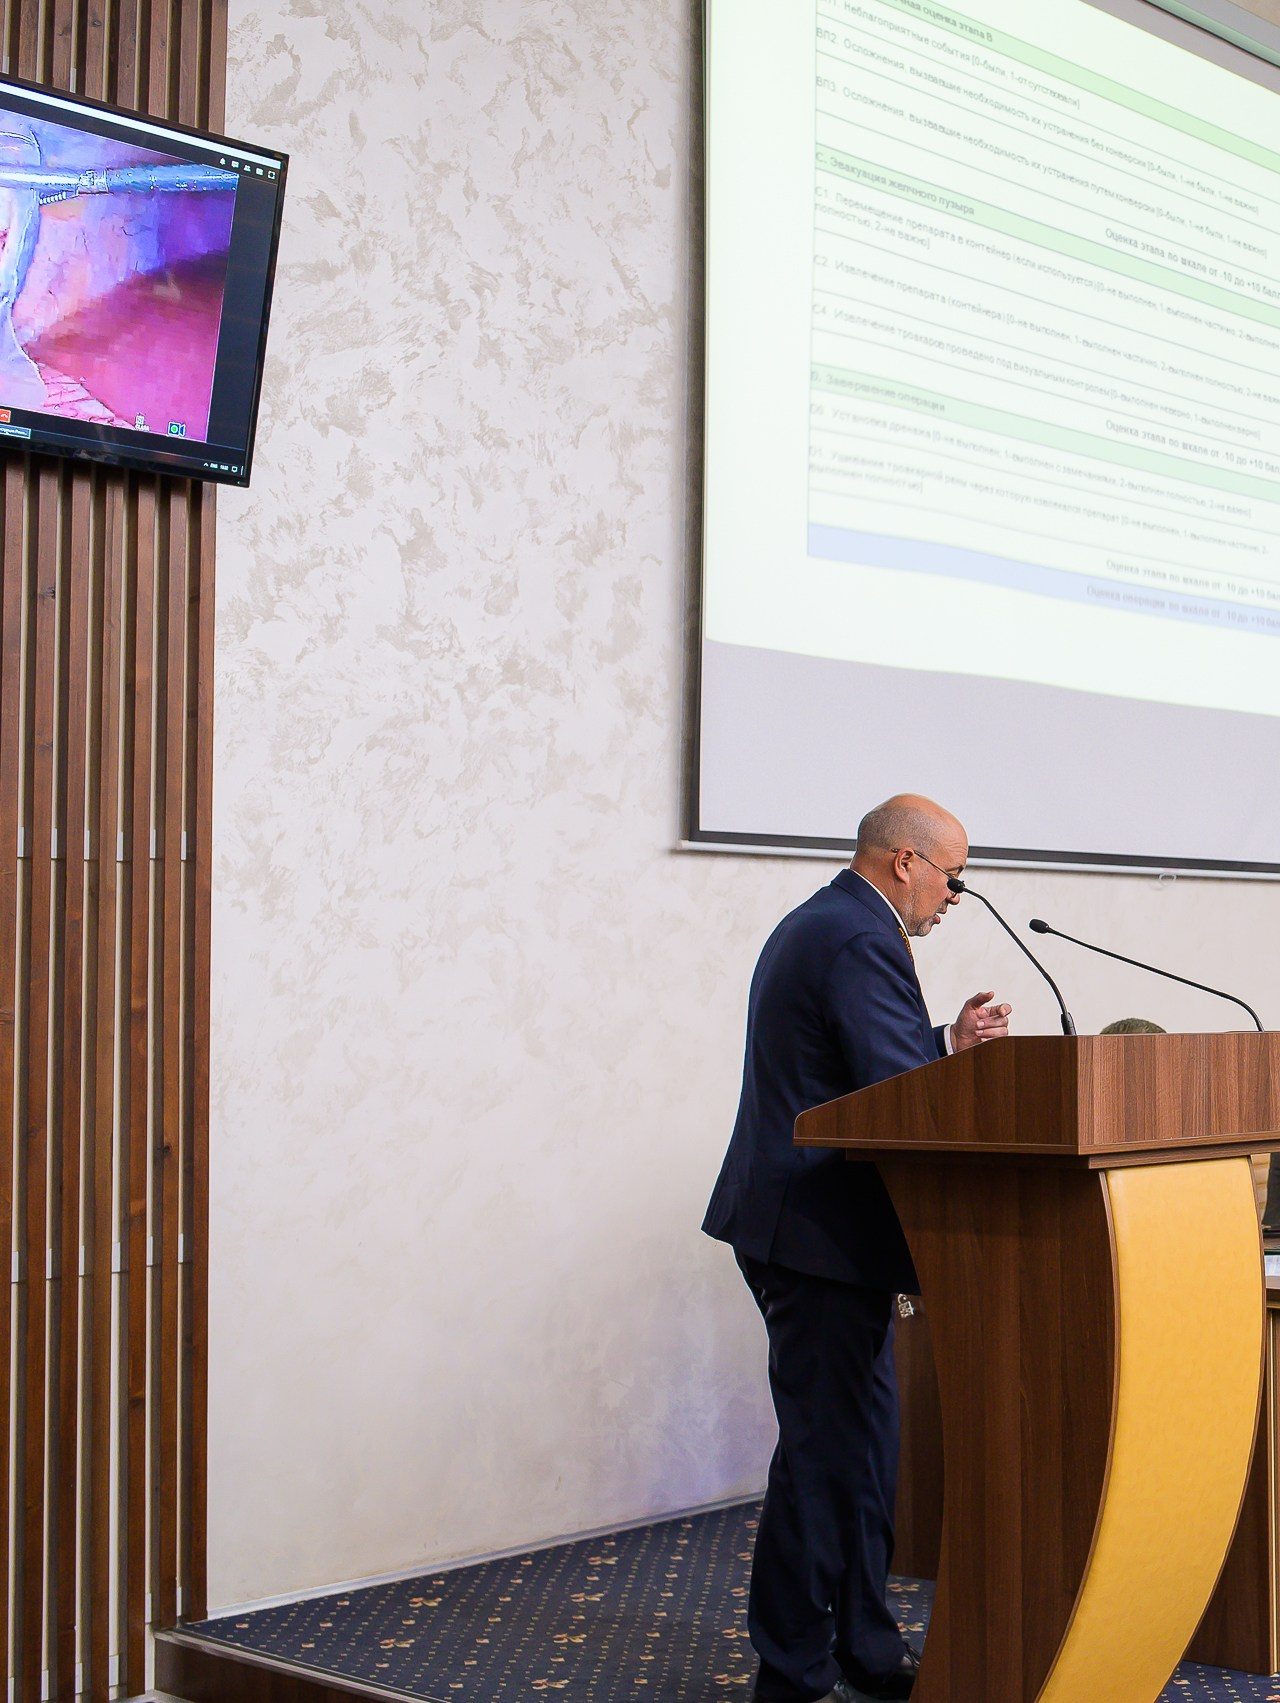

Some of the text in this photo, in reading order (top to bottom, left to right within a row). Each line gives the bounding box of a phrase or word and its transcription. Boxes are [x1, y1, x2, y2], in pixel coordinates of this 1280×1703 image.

[844, 1, 928, 45] Неблагоприятные
[932, 40, 970, 61] события
[924, 7, 956, 27] оценка
[959, 22, 984, 39] этапа
[909, 67, 961, 93] вызвавшие
[963, 89, 1029, 121] необходимость
[1032, 117, 1040, 125] их
[1043, 122, 1089, 144] устранения
[1091, 138, 1104, 151] без
[1105, 147, 1146, 167] конверсии
[909, 113, 961, 139] вызвавшие
[963, 135, 1029, 166] необходимость
[1032, 162, 1040, 170] их
[1043, 165, 1089, 187] устранения
[830, 157, 886, 184] Эвакуация
[888, 180, 936, 202] желчного
[939, 197, 975, 215] пузыря
[836, 192, 903, 224] Перемещение
[906, 219, 956, 241] препарата
[958, 236, 964, 244] в
[966, 240, 1011, 261] контейнер
[1105, 228, 1138, 248] Оценка
[1141, 242, 1165, 258] этапа
[1168, 252, 1178, 262] по
[1181, 257, 1207, 273] шкале
[1208, 268, 1217, 276] от
[1234, 277, 1244, 287] до
[897, 282, 946, 303] препарата
[946, 343, 994, 363] проведено
[996, 357, 1012, 370] под
[1106, 420, 1139, 437] Оценка
[1142, 431, 1166, 444] этапа
[1169, 438, 1179, 448] по
[1182, 442, 1208, 455] шкале
[1210, 449, 1219, 458] от
[1236, 456, 1247, 465] до
[1106, 560, 1139, 575] Оценка
[1142, 569, 1166, 580] этапа
[1169, 573, 1180, 582] по
